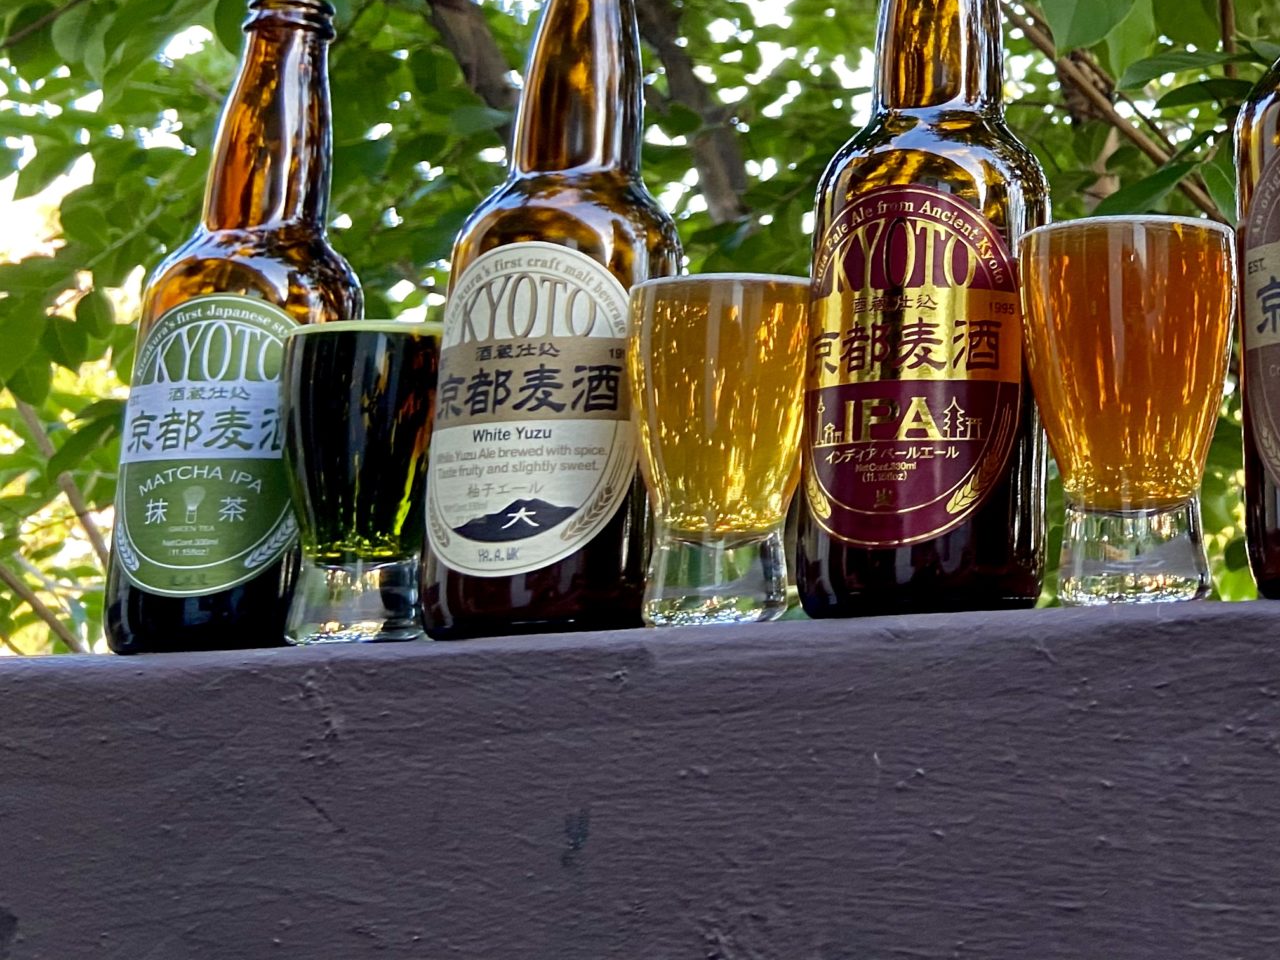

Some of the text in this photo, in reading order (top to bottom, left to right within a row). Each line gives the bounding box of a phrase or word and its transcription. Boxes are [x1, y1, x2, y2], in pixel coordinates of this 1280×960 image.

[826, 222, 848, 251] Pale
[851, 206, 873, 223] Ale
[877, 200, 913, 215] from
[919, 200, 980, 240] Ancient
[976, 236, 1004, 284] Kyoto
[831, 217, 977, 291] KYOTO
[177, 307, 202, 325] first
[207, 304, 271, 325] Japanese
[461, 272, 597, 342] KYOTO
[494, 257, 523, 273] first
[528, 257, 561, 271] craft
[563, 265, 595, 286] malt
[594, 282, 626, 334] beverage
[988, 302, 1015, 316] 1995
[438, 364, 622, 420] 京都麦酒
[473, 427, 552, 443] White Yuzu
[844, 396, 944, 444] IPA
[458, 464, 485, 478] fruity
[487, 462, 509, 475] and
[512, 460, 557, 475] slightly
[478, 448, 496, 459] Ale
[498, 446, 544, 458] brewed
[546, 445, 572, 456] with
[139, 465, 263, 497] MATCHA IPA
